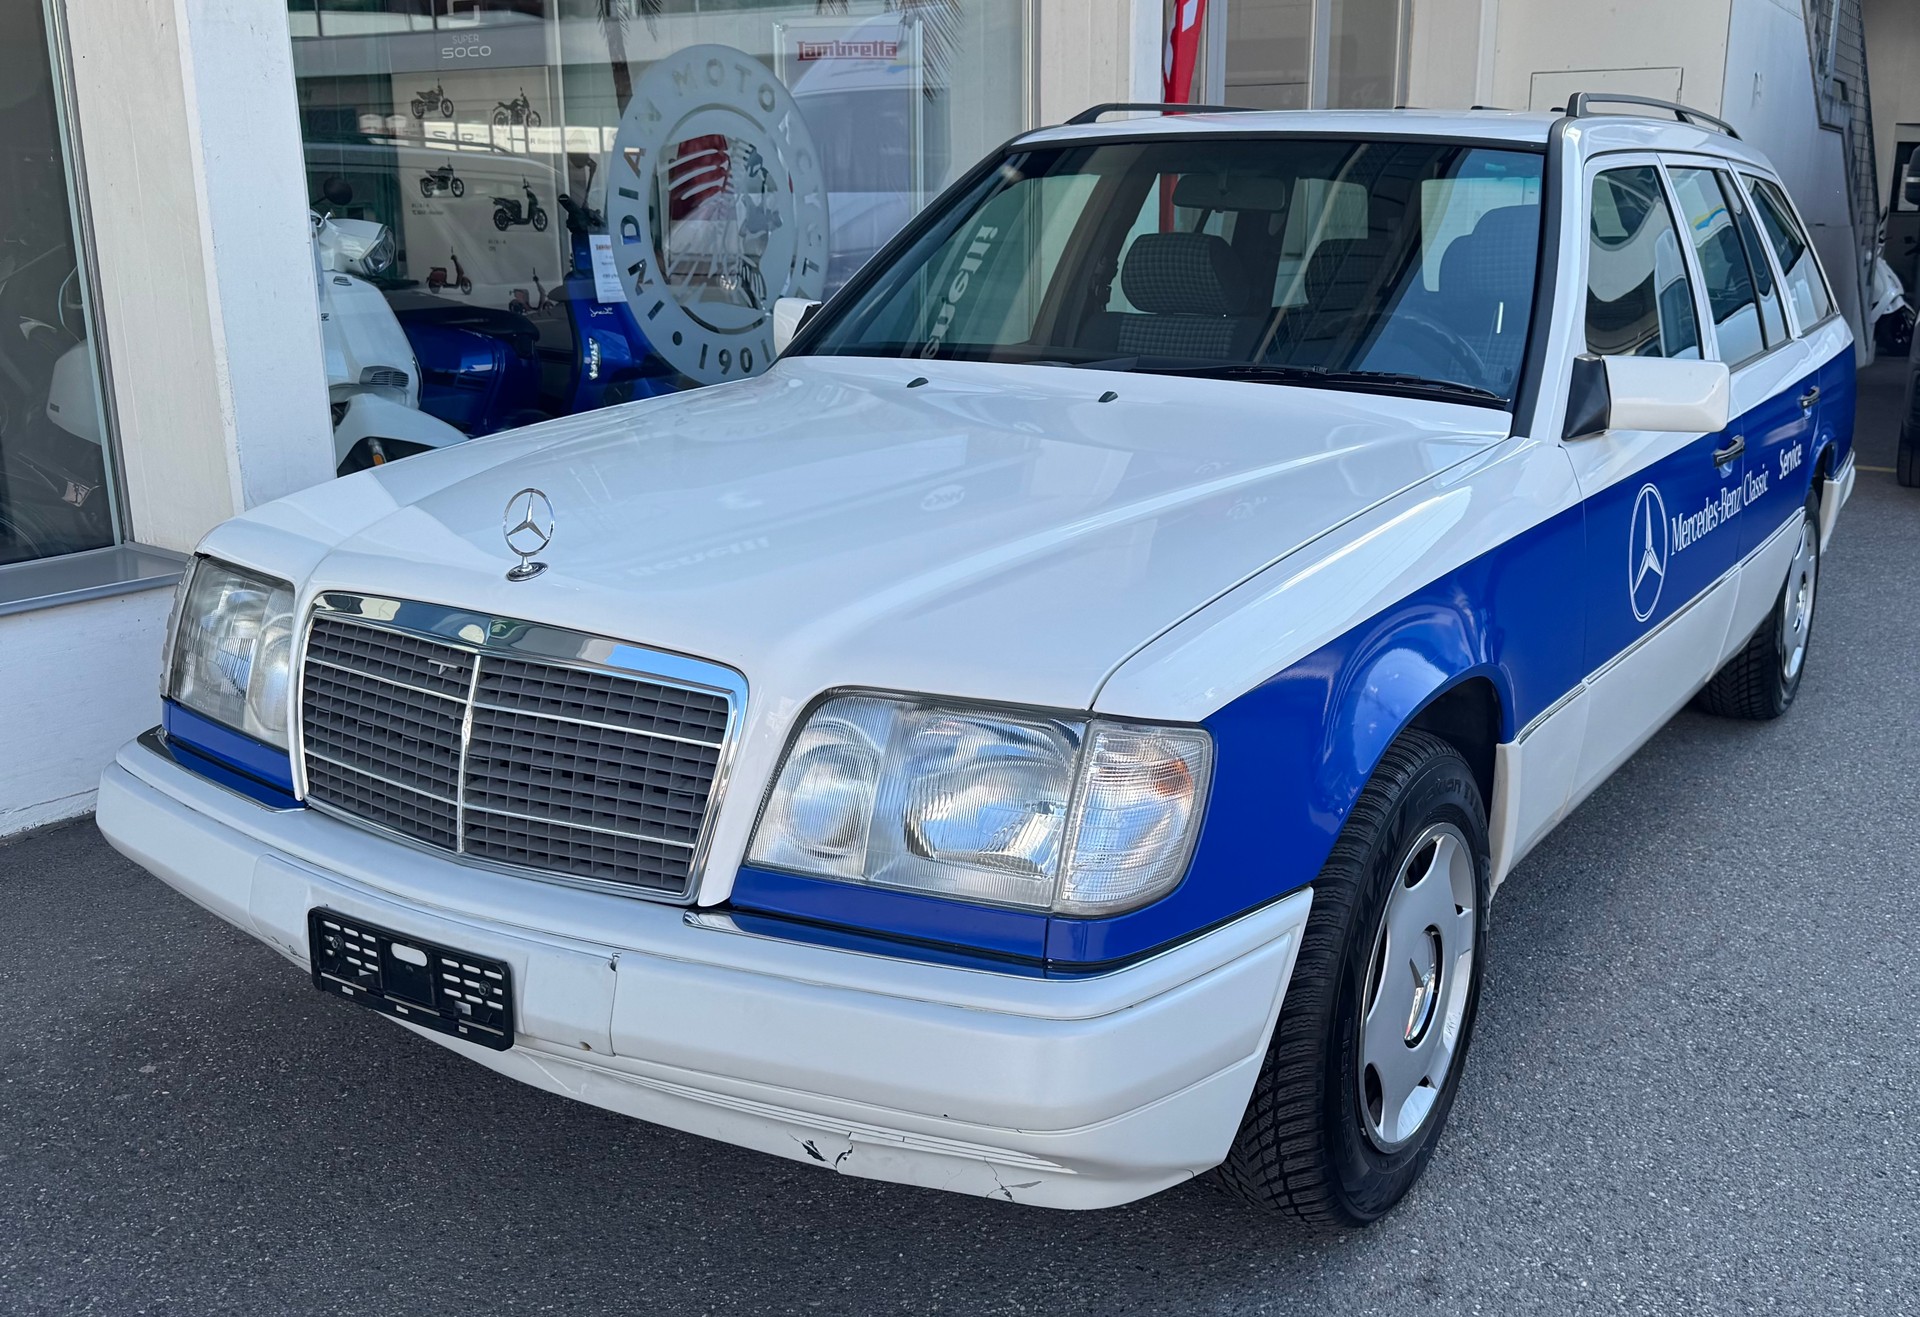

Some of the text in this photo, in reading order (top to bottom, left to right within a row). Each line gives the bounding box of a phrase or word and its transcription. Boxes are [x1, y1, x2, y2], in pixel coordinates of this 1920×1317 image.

[452, 34, 480, 44] SUPER
[442, 46, 492, 59] SOCO
[699, 338, 771, 376] 1901
[1671, 440, 1802, 556] Mercedes-Benz Classic Service
